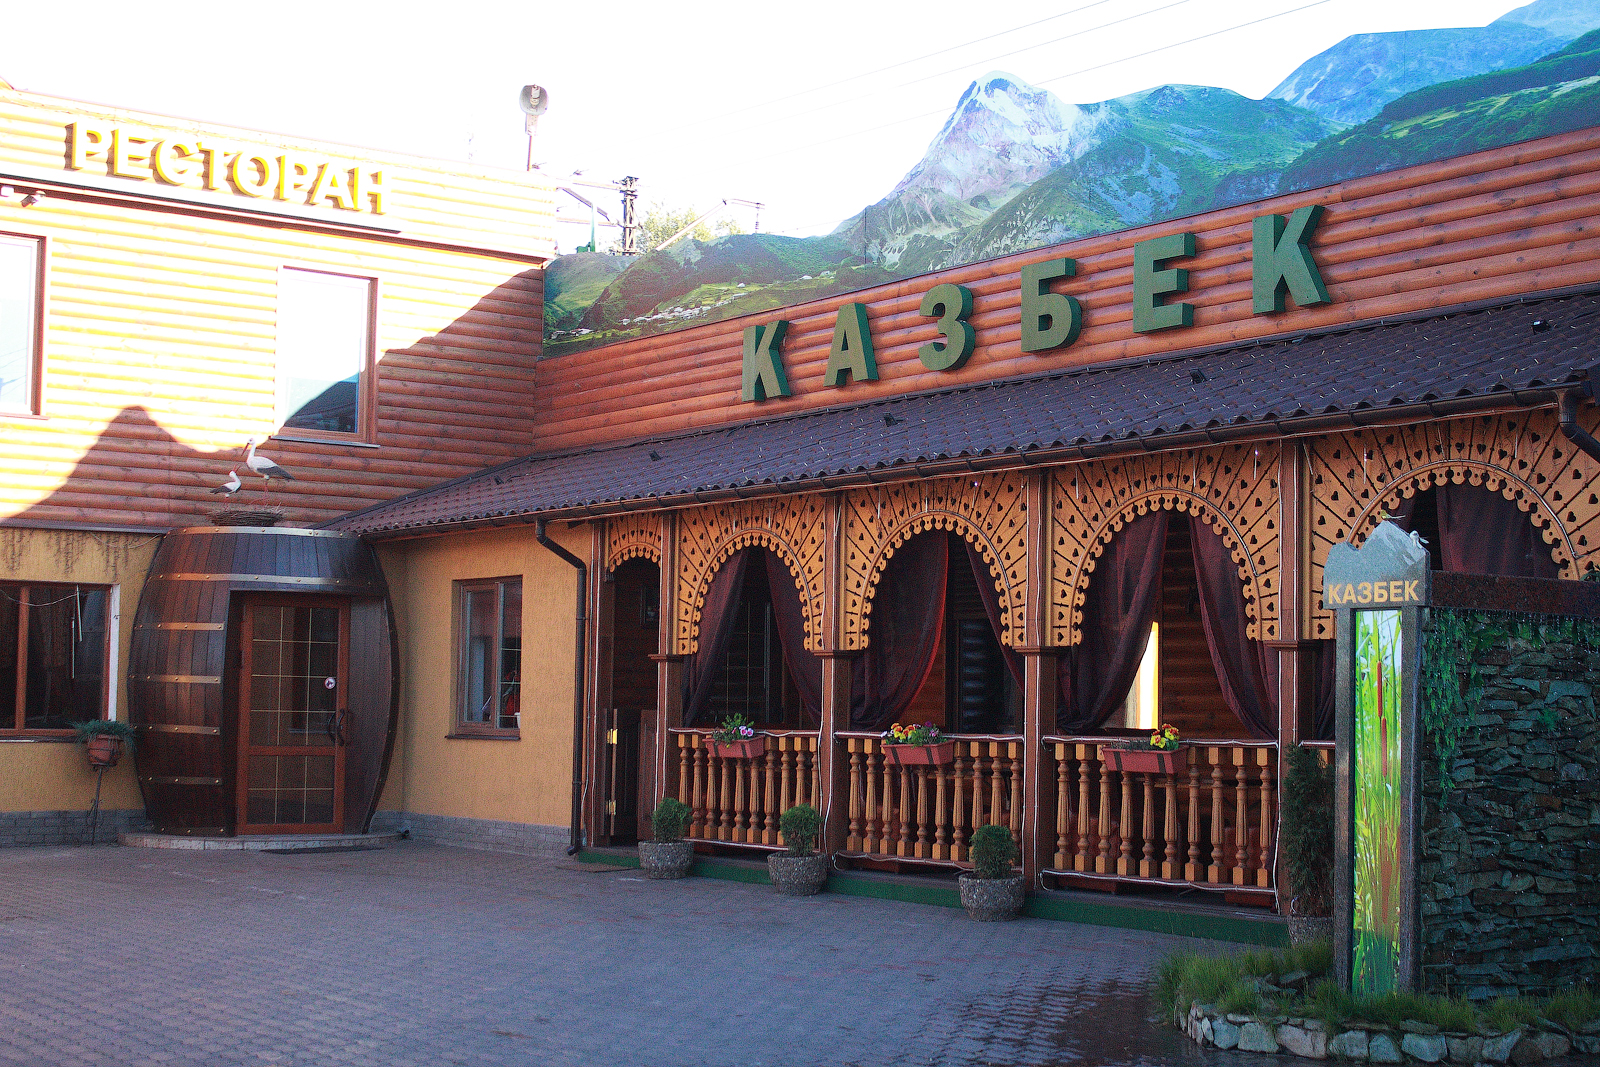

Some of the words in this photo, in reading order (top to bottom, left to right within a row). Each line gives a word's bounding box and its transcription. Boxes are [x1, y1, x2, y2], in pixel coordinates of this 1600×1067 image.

[70, 121, 387, 213] РЕСТОРАН
[741, 205, 1331, 402] КАЗБЕК
[1328, 580, 1419, 604] КАЗБЕК
